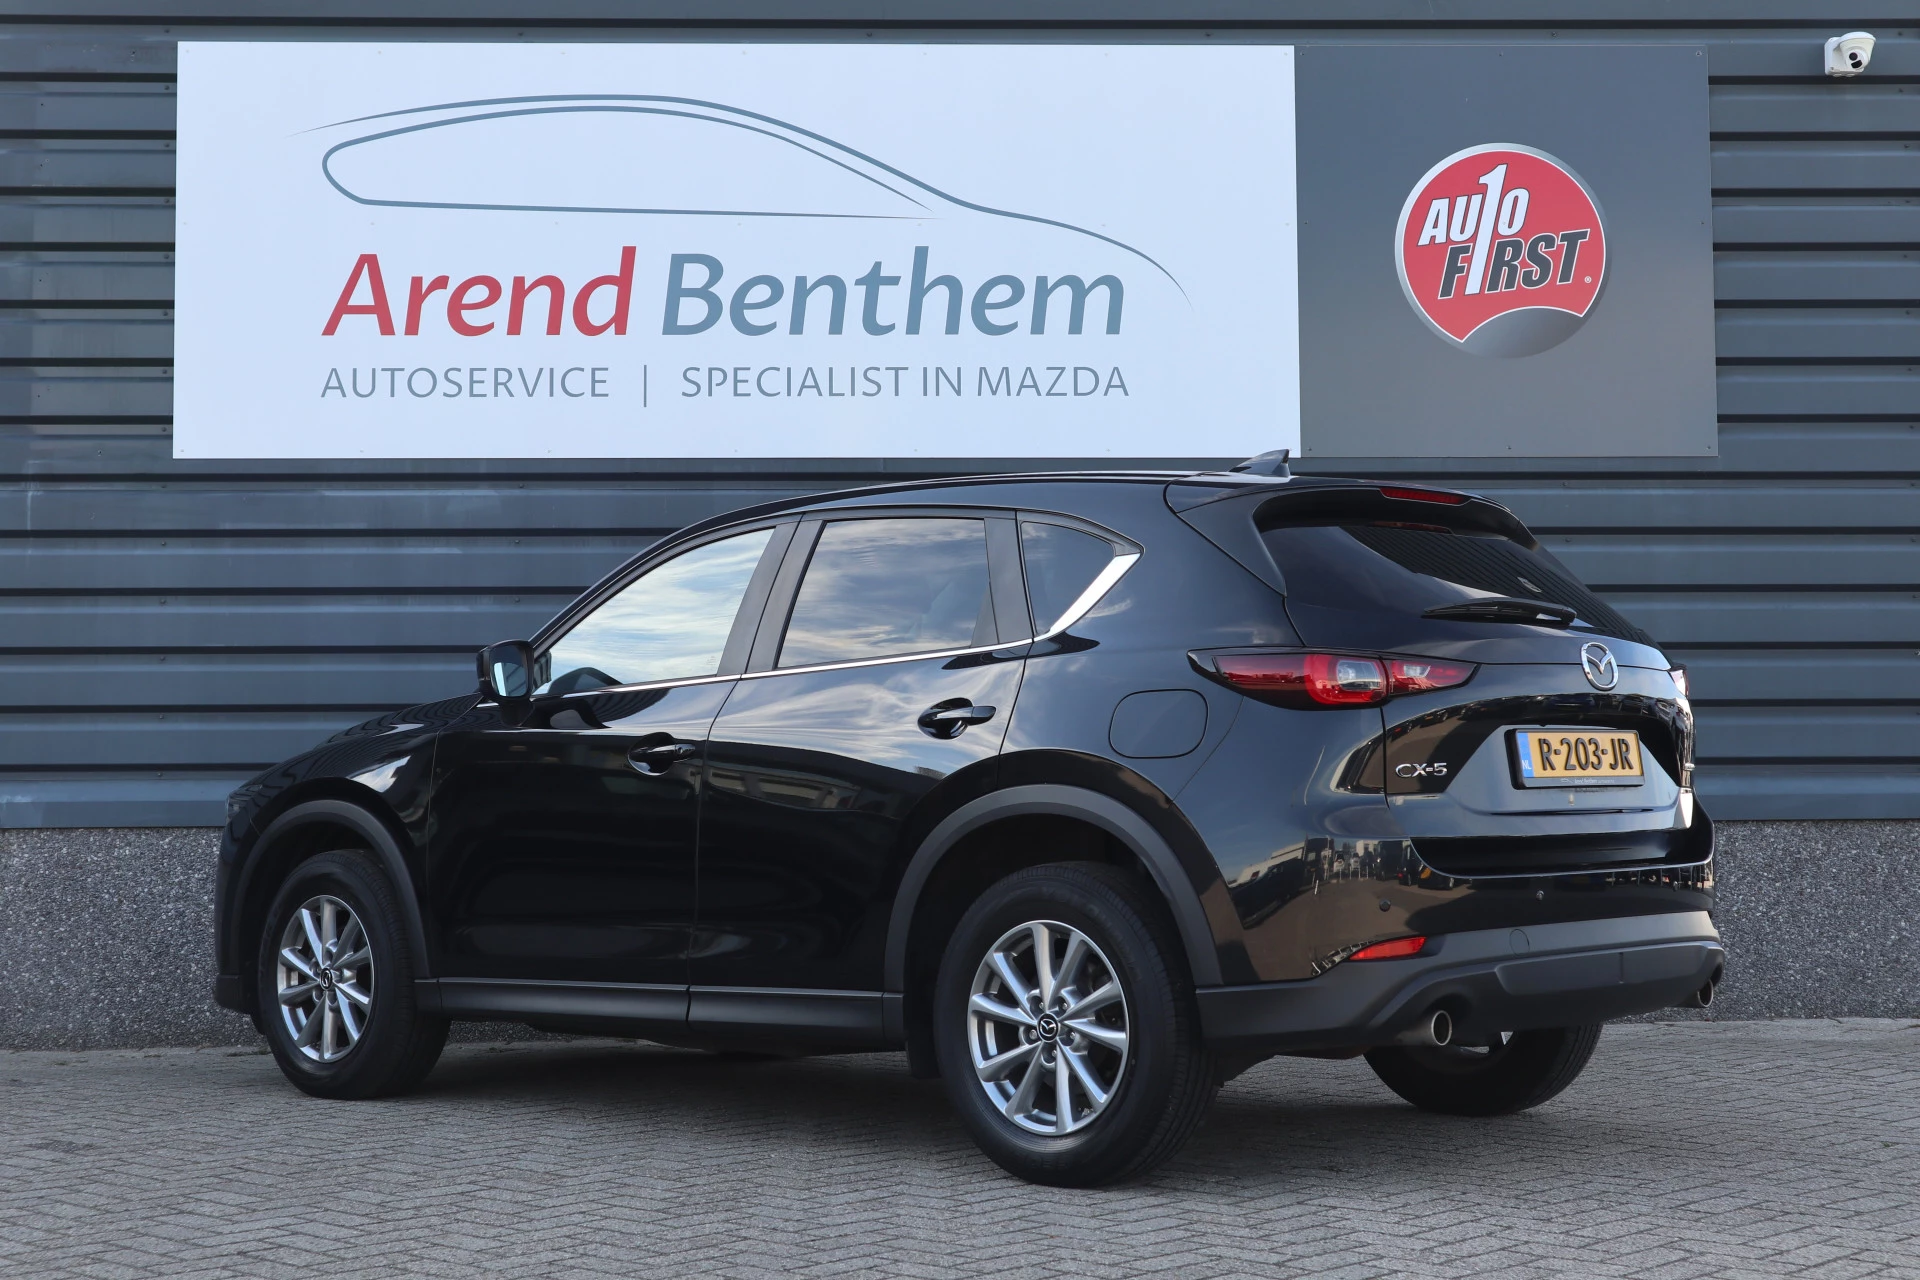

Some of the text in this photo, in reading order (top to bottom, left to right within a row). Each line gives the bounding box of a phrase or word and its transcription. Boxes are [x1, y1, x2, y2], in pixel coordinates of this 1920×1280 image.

[321, 245, 1125, 337] Arend Benthem
[320, 366, 1130, 399] AUTOSERVICE SPECIALIST IN MAZDA
[1395, 762, 1448, 778] CX-5
[1521, 759, 1532, 770] NL
[1537, 737, 1634, 771] R-203-JR
